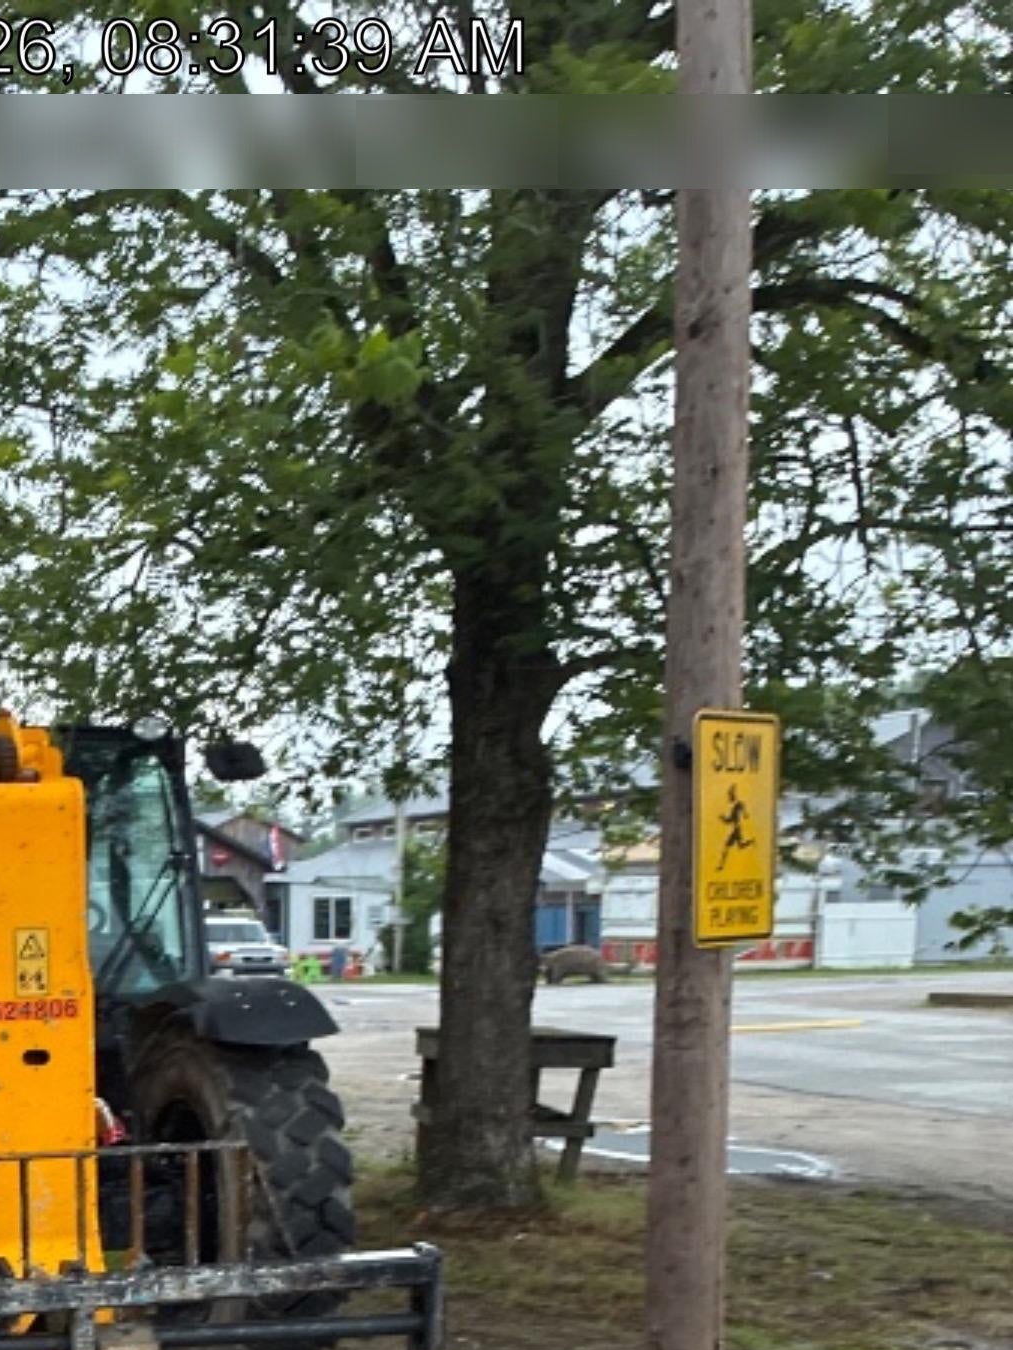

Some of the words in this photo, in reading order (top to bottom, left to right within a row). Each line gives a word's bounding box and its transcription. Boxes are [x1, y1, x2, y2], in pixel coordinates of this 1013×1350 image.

[712, 731, 762, 773] SLOW
[707, 879, 763, 901] CHILDREN
[709, 905, 758, 928] PLAYING
